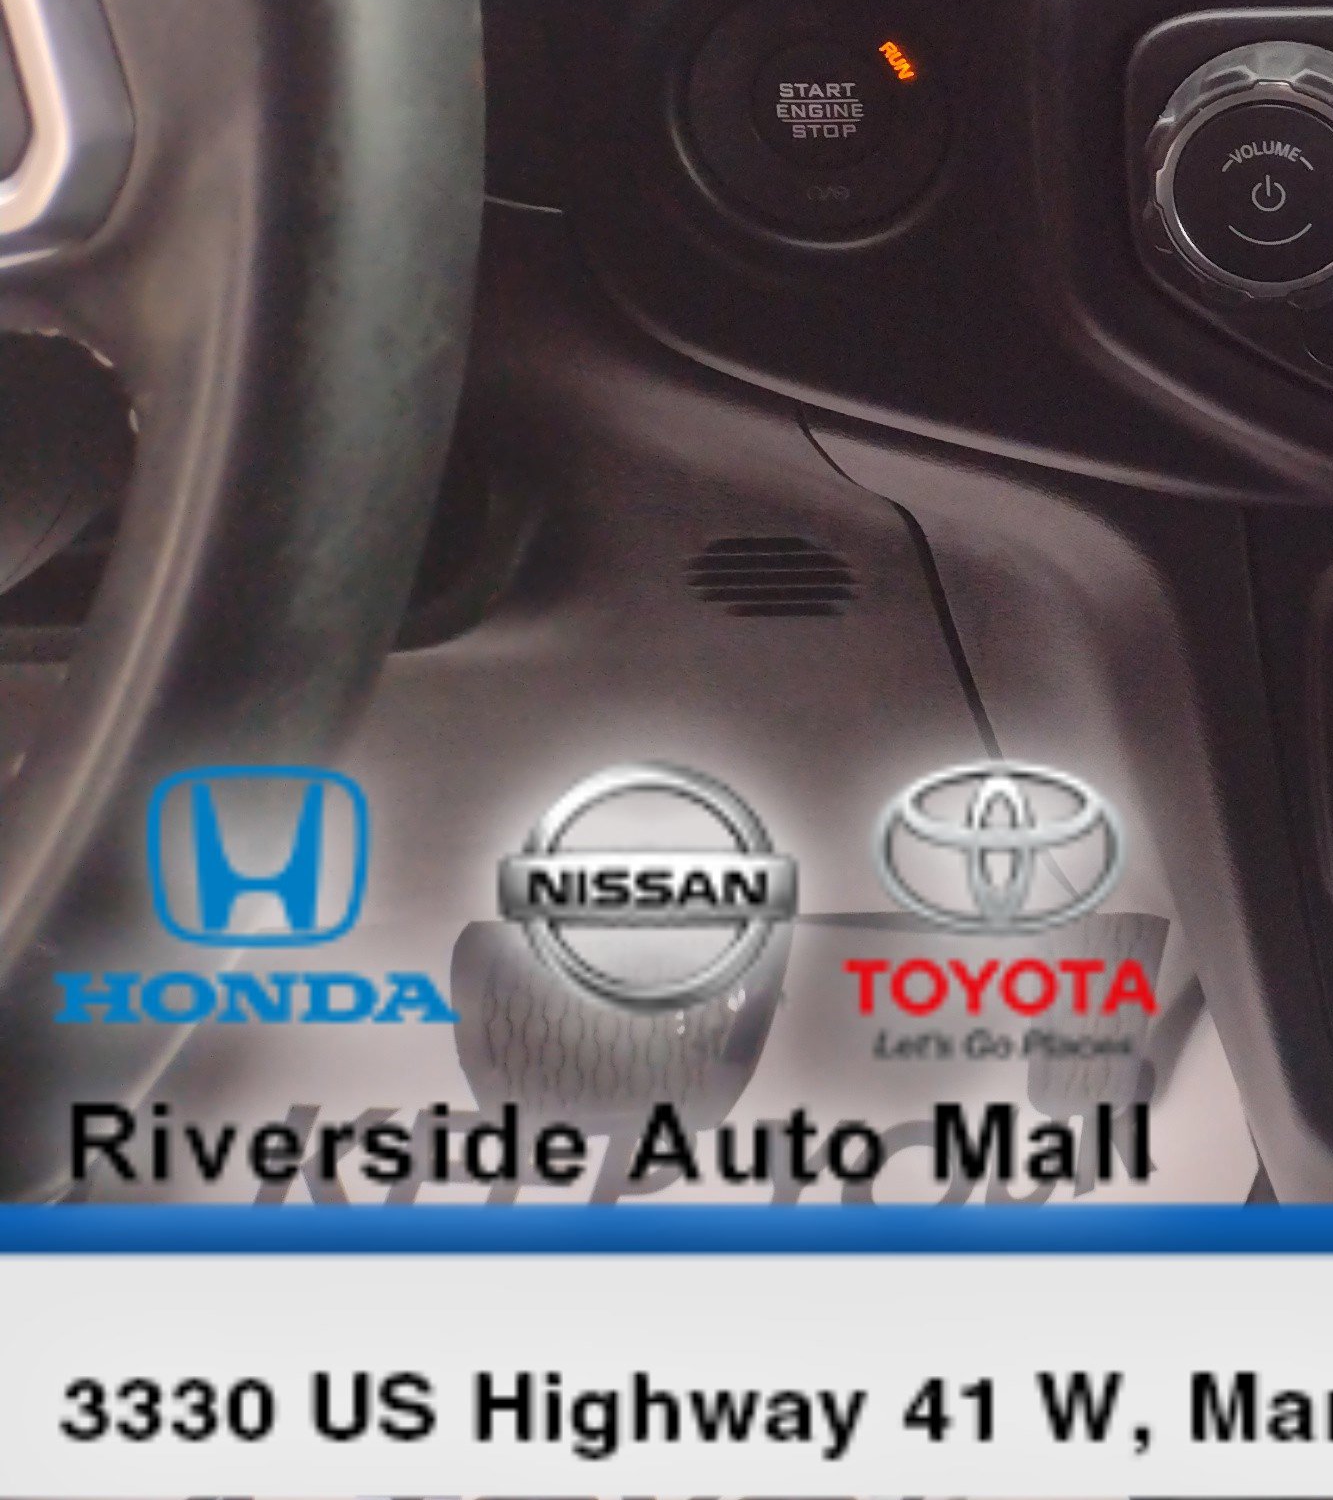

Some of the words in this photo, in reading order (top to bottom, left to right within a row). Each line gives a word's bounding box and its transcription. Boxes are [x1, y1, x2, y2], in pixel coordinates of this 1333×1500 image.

[878, 41, 914, 80] RUN
[779, 82, 856, 98] START
[776, 103, 864, 119] ENGINE
[792, 124, 857, 139] STOP
[1230, 140, 1302, 165] VOLUME
